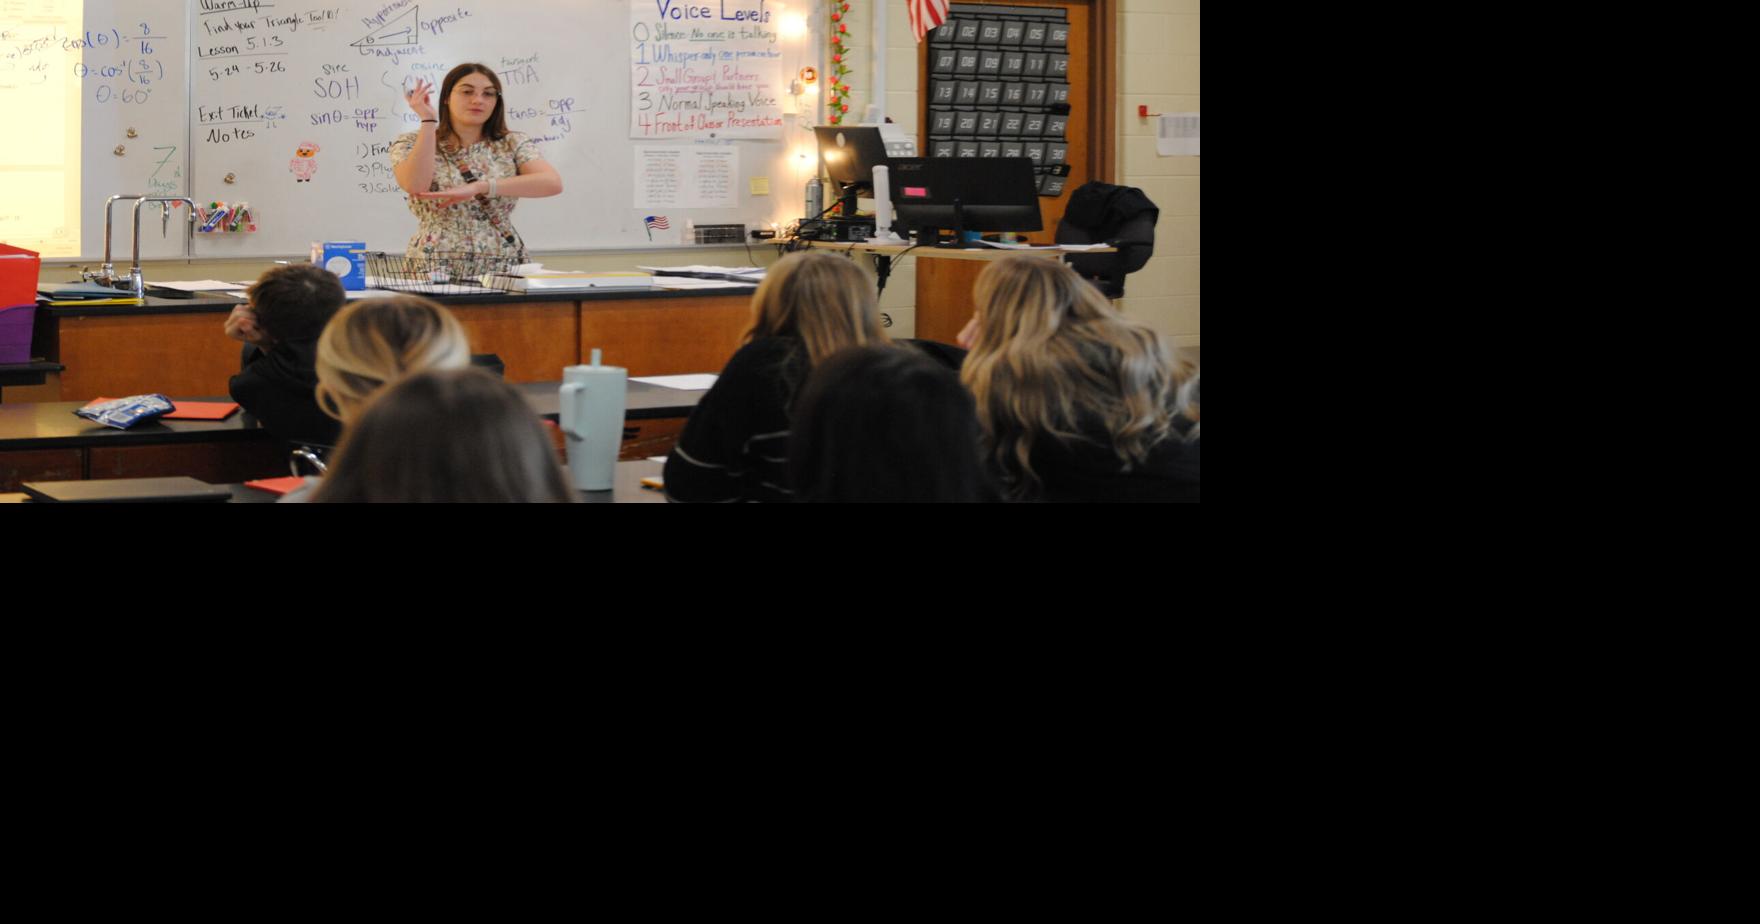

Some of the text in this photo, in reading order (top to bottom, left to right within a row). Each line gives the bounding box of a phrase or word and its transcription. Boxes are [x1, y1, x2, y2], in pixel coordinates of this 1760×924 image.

[656, 0, 771, 22] Voice Levels
[741, 26, 777, 43] talking
[940, 26, 1068, 41] 01 02 03 04 05 06
[197, 35, 285, 58] Lesson 5.1.3
[635, 42, 650, 64] 1
[940, 56, 954, 67] 07
[984, 57, 1001, 69] 09
[1008, 59, 1022, 69] 10
[1030, 60, 1044, 70] 11
[1053, 60, 1068, 71] 12
[497, 65, 541, 86] TOA
[636, 65, 654, 87] 2
[314, 75, 360, 101] SOH
[940, 87, 953, 98] 13
[962, 88, 976, 98] 14
[985, 87, 999, 99] 15
[1007, 89, 1021, 100] 16
[1031, 90, 1045, 100] 17
[638, 91, 653, 111] 3
[658, 93, 703, 113] Normal
[749, 92, 777, 108] Voice
[199, 105, 224, 123] Exit
[938, 118, 1066, 131] 19 20 21 22 23 24
[206, 127, 255, 144] Notes
[638, 114, 651, 136] 4
